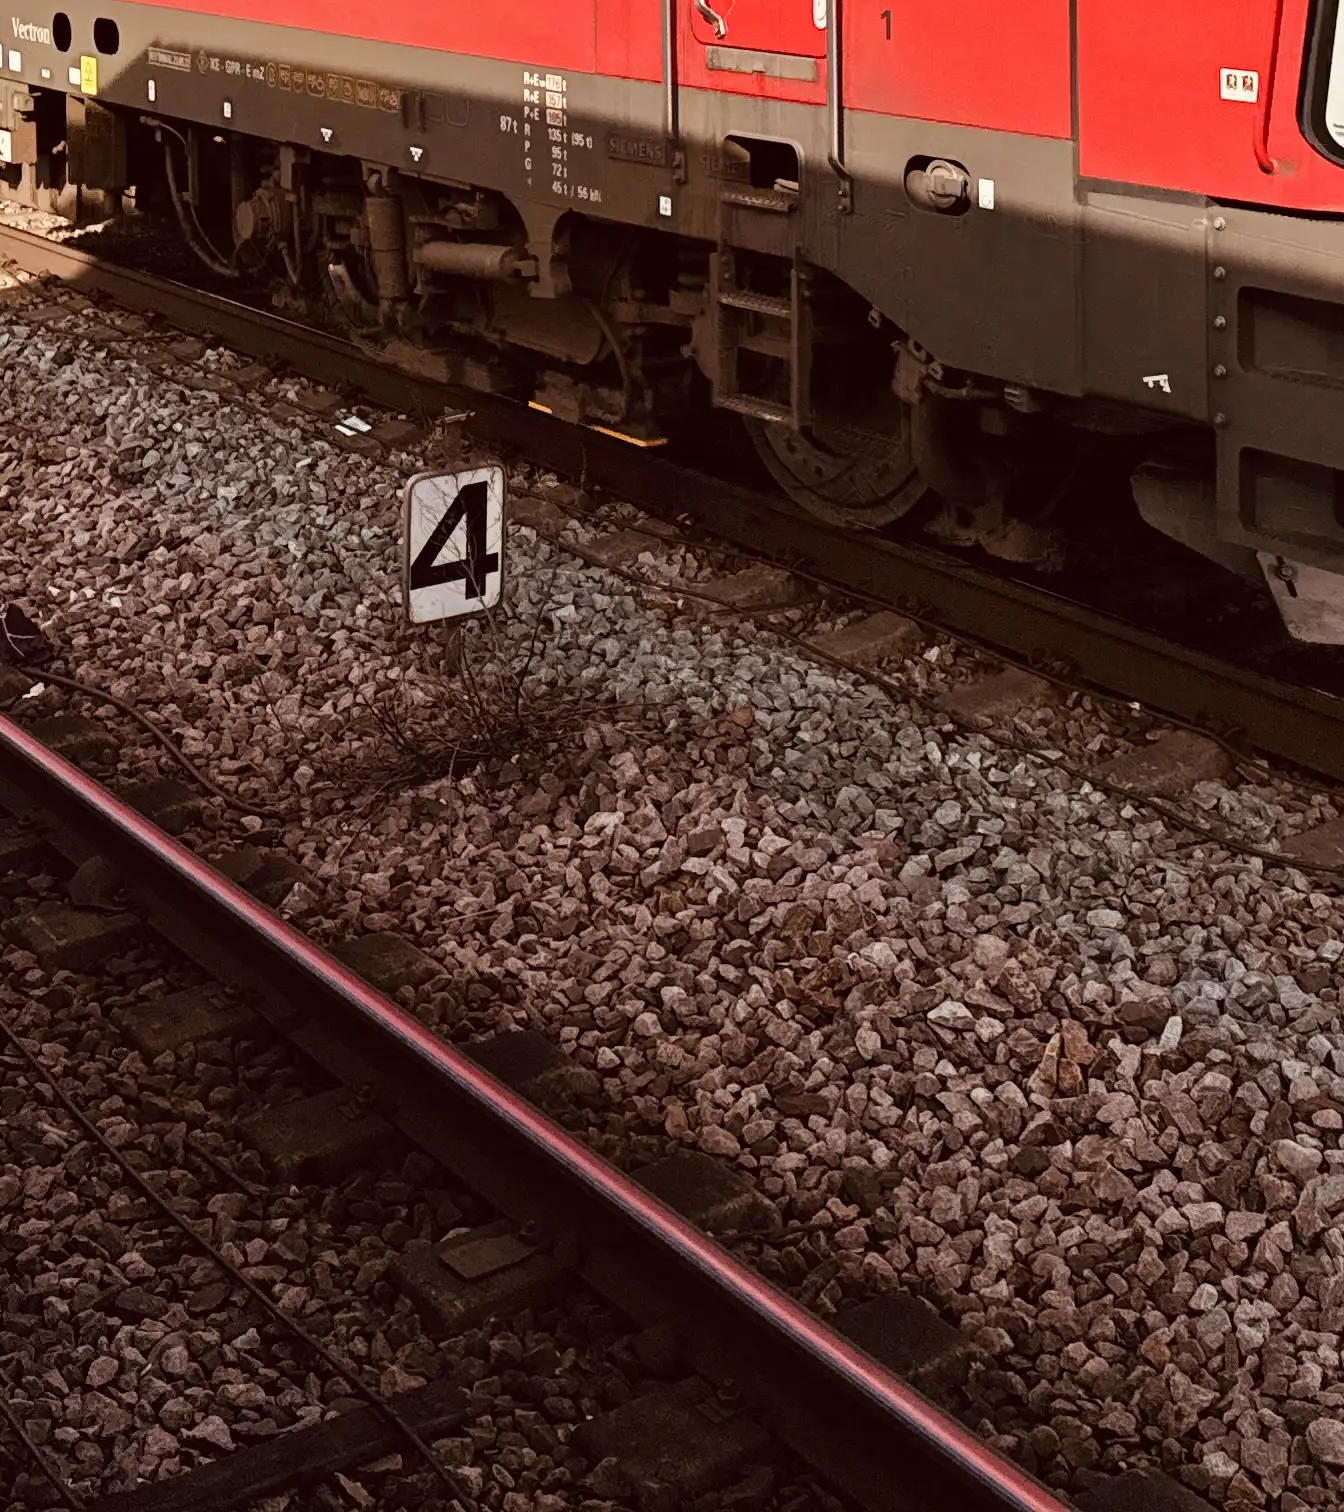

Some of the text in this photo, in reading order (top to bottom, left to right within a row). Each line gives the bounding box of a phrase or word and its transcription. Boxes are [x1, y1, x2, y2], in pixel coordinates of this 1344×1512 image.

[11, 17, 51, 44] Vectron
[880, 10, 892, 40] 1
[608, 138, 663, 160] SIEMENS
[410, 480, 499, 600] 4
